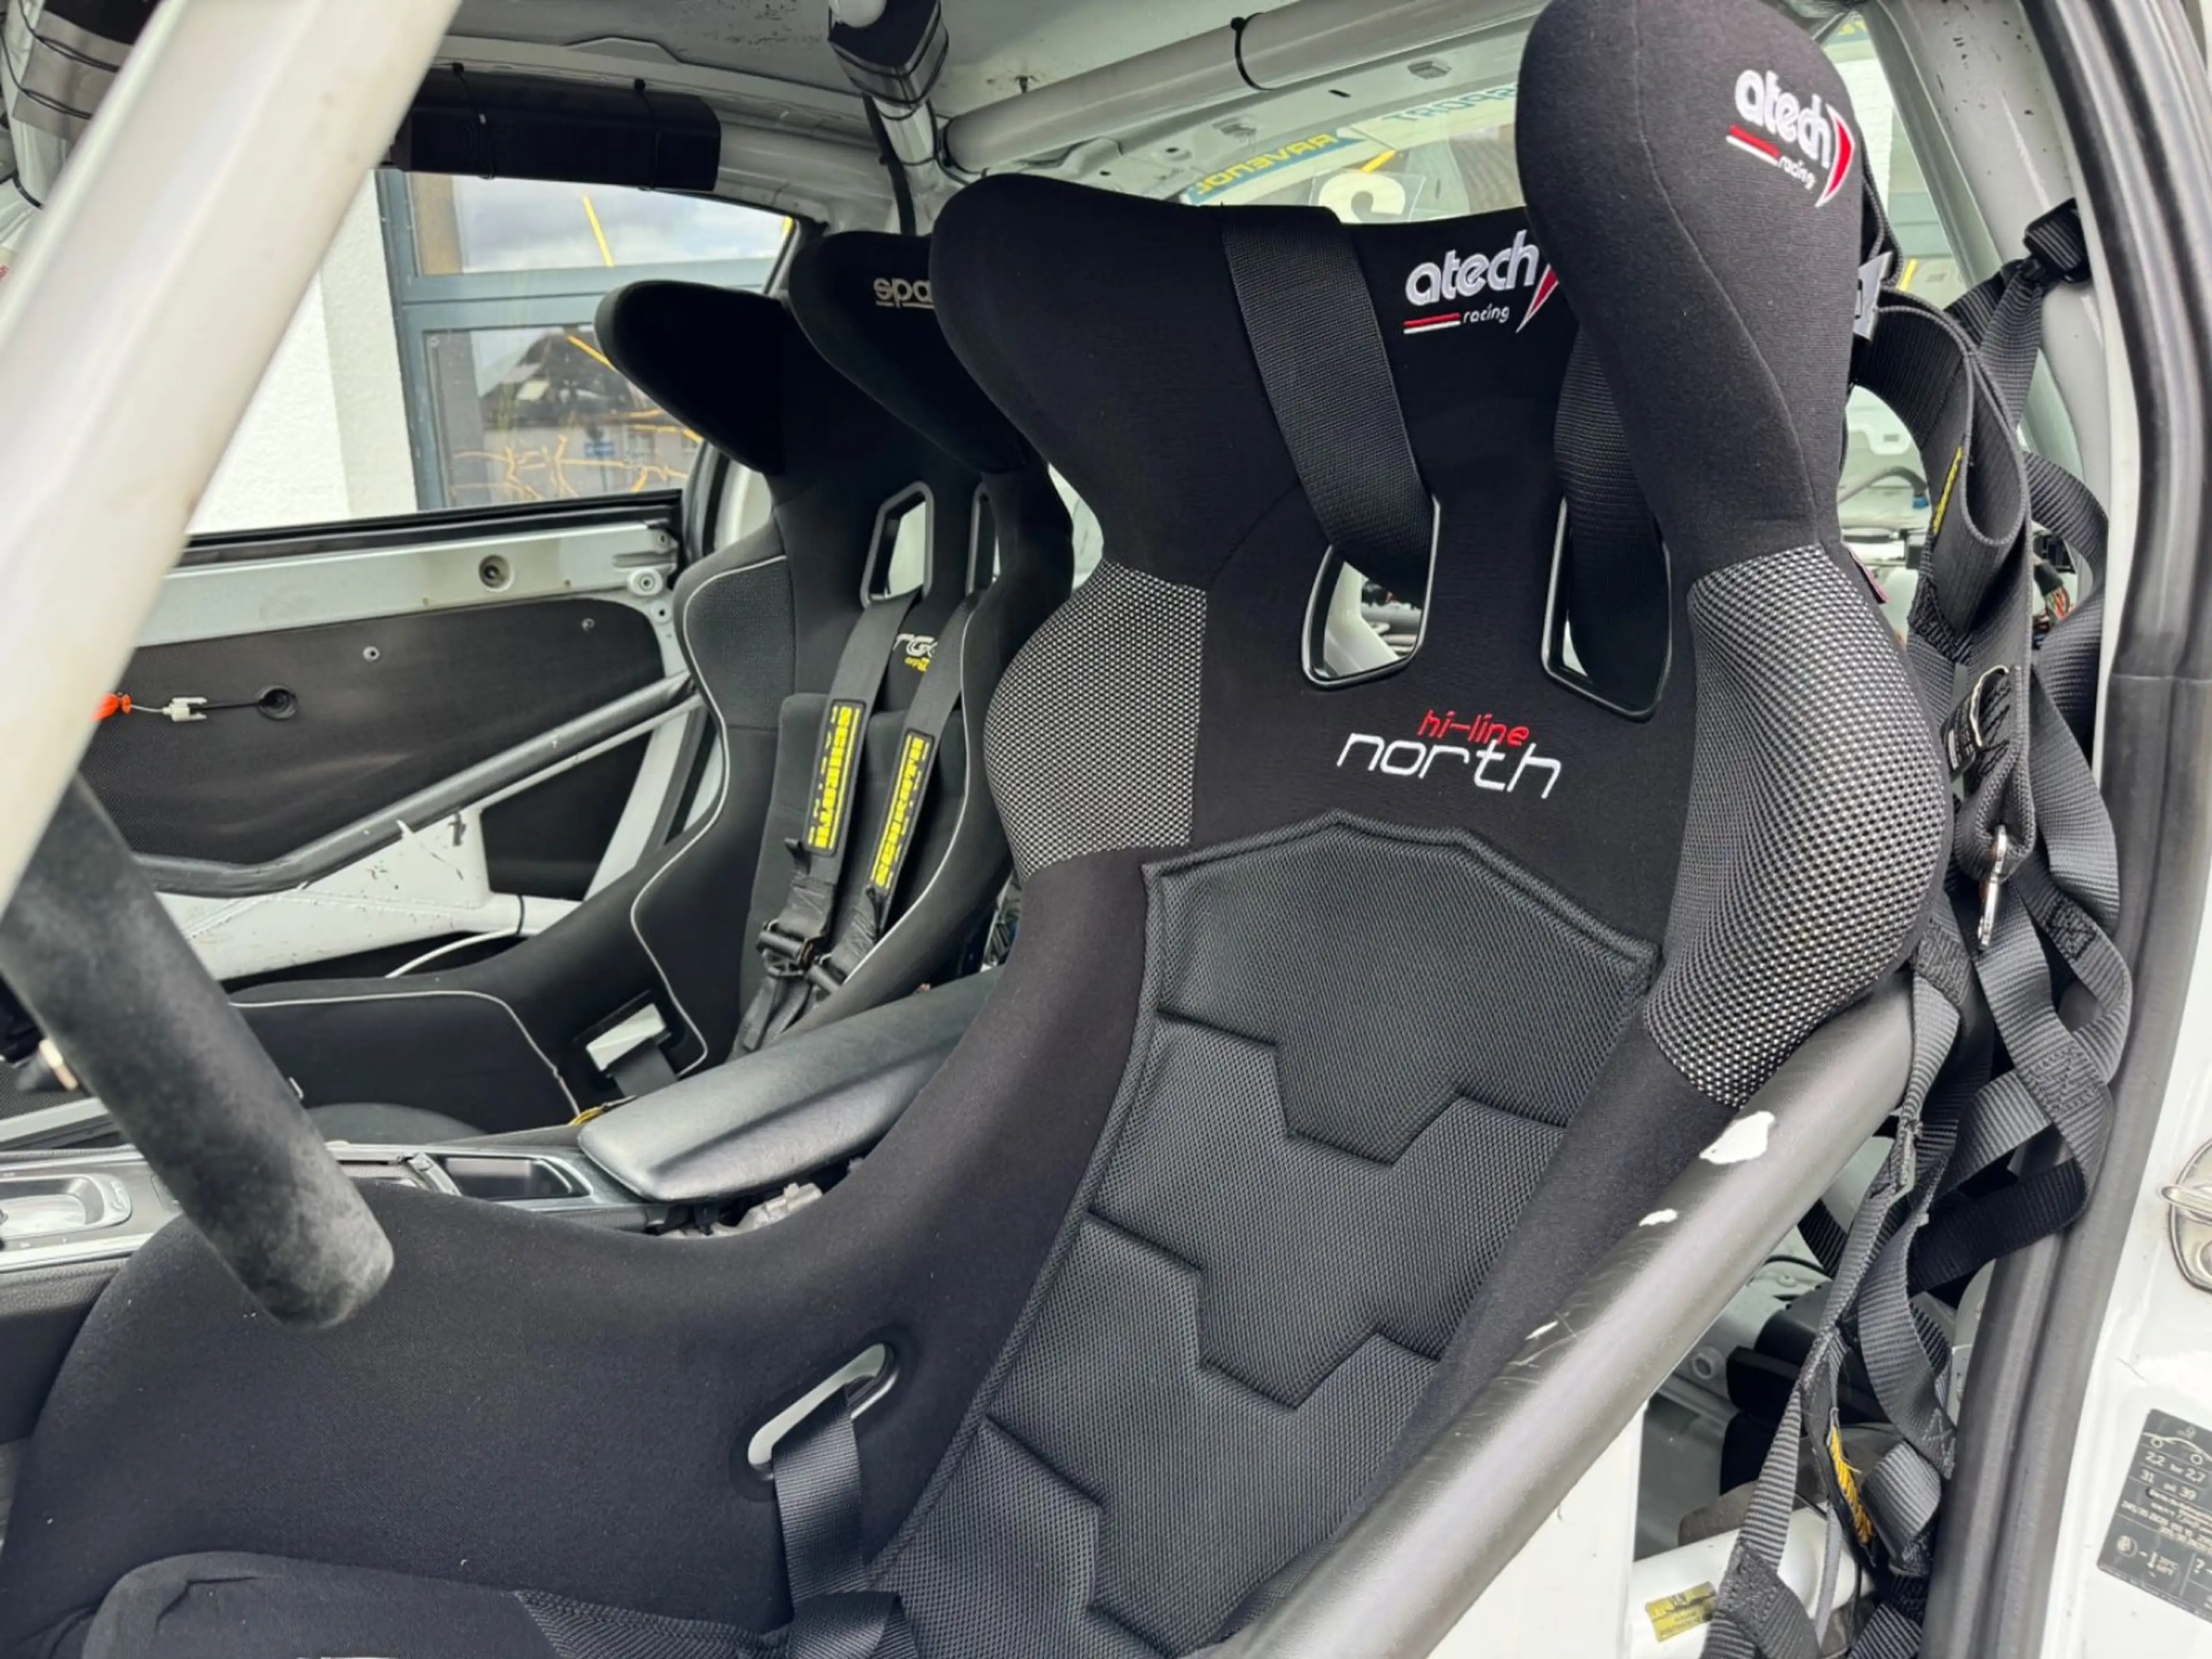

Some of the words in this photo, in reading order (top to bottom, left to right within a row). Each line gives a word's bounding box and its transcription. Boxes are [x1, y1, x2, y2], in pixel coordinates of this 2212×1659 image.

[1734, 69, 1831, 169] atech
[1405, 229, 1540, 306] atech
[1463, 302, 1510, 324] racing
[1416, 709, 1531, 747] hi-line
[1336, 732, 1562, 800] north
